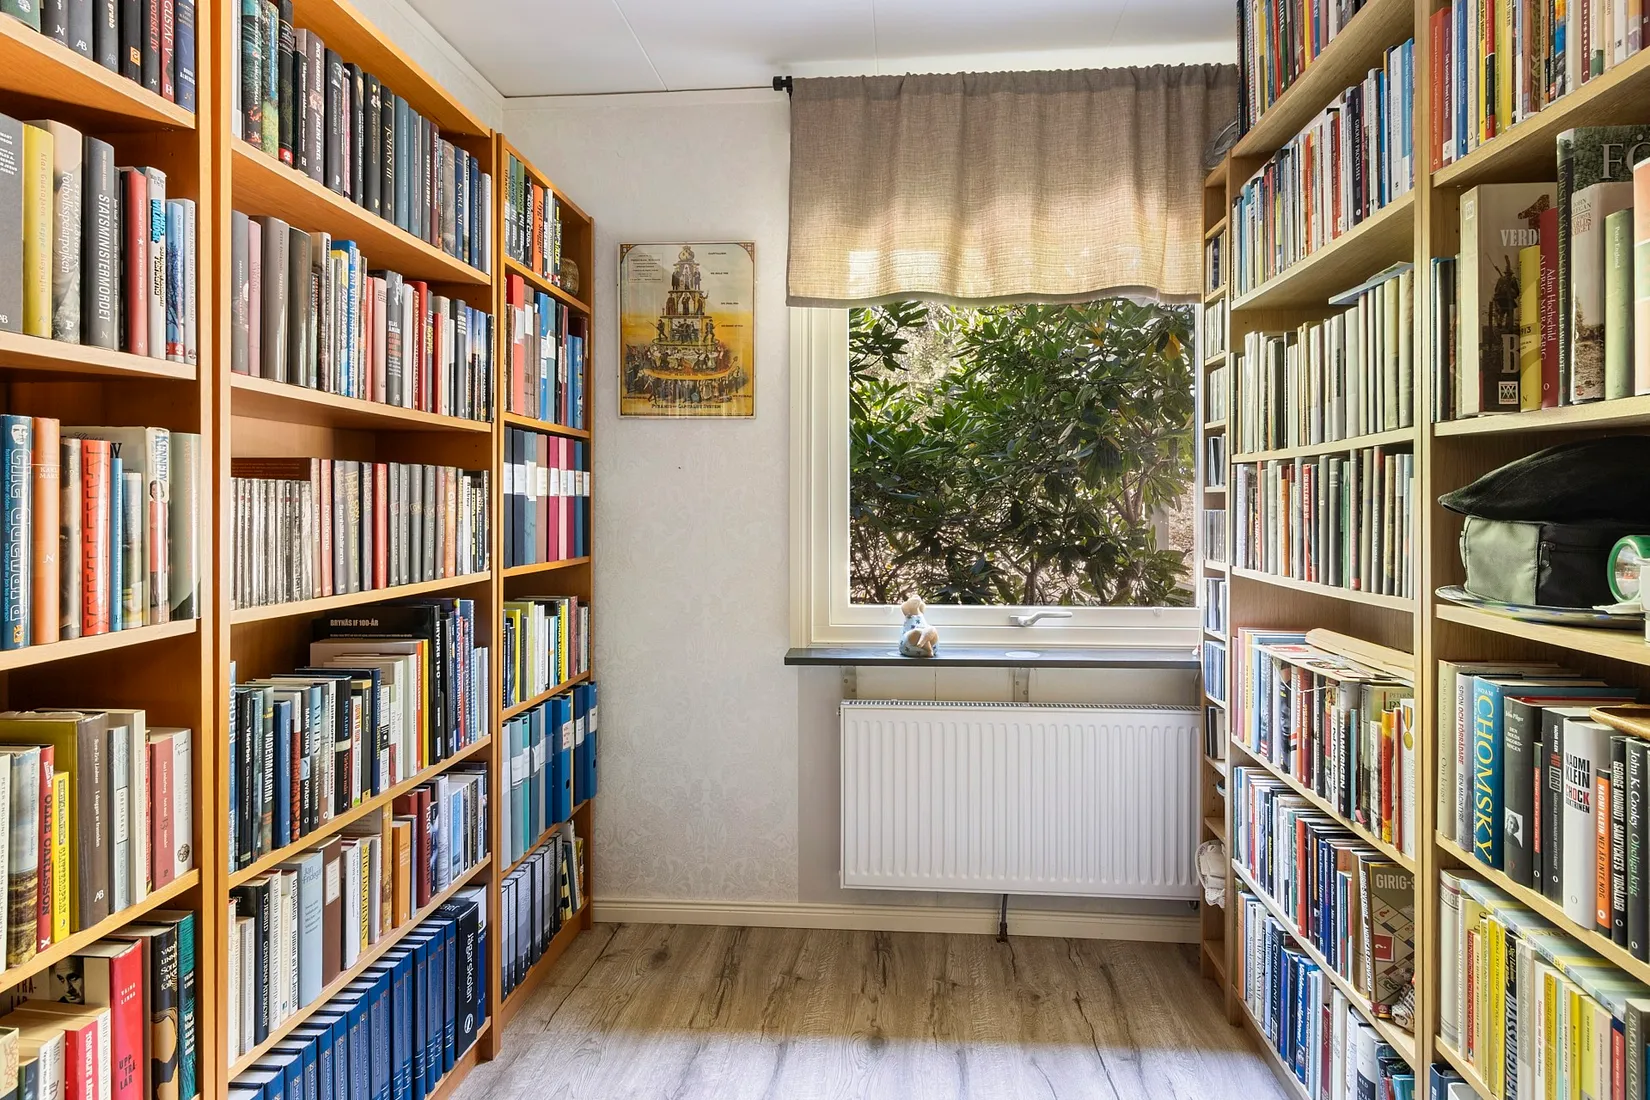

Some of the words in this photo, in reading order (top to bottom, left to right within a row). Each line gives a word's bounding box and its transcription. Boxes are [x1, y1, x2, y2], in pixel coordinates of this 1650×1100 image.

[385, 126, 393, 166] JOHAN
[58, 170, 74, 274] Fotbollsspelarpojken
[1613, 225, 1621, 242] Peter
[1500, 228, 1541, 247] VERD
[98, 194, 111, 322] STATSMINISTERMORDET
[1613, 242, 1621, 269] Englund
[1547, 268, 1557, 293] Adam
[1547, 293, 1557, 342] Hochschild
[155, 434, 169, 483] KENNEDY
[330, 618, 352, 627] BRYNÄS
[1442, 757, 1448, 777] Om
[1566, 752, 1590, 773] NAOMI
[1613, 760, 1624, 788] GEORGE
[1629, 749, 1640, 775] John
[1475, 694, 1494, 864] CHOMSKY
[1550, 767, 1561, 791] LOGO
[1566, 765, 1590, 789] KLEIN
[1629, 775, 1640, 789] K.
[1597, 783, 1606, 811] NAOMI
[1613, 787, 1624, 822] MONBIOT
[1629, 789, 1640, 829] Cooley
[43, 793, 53, 835] OLLE
[1597, 812, 1606, 834] KLEIN
[1597, 834, 1606, 850] NEJ
[1597, 850, 1606, 861] ÄR
[1613, 823, 1624, 872] SAMTYCKETS
[1629, 832, 1640, 874] Oheliga
[43, 836, 53, 917] CARLSSON
[1597, 863, 1606, 881] INTE
[1597, 881, 1606, 899] NOG
[1613, 872, 1624, 912] TIDSÅLDER
[1629, 874, 1640, 898] krig
[1629, 1011, 1637, 1072] DEMOKRATI
